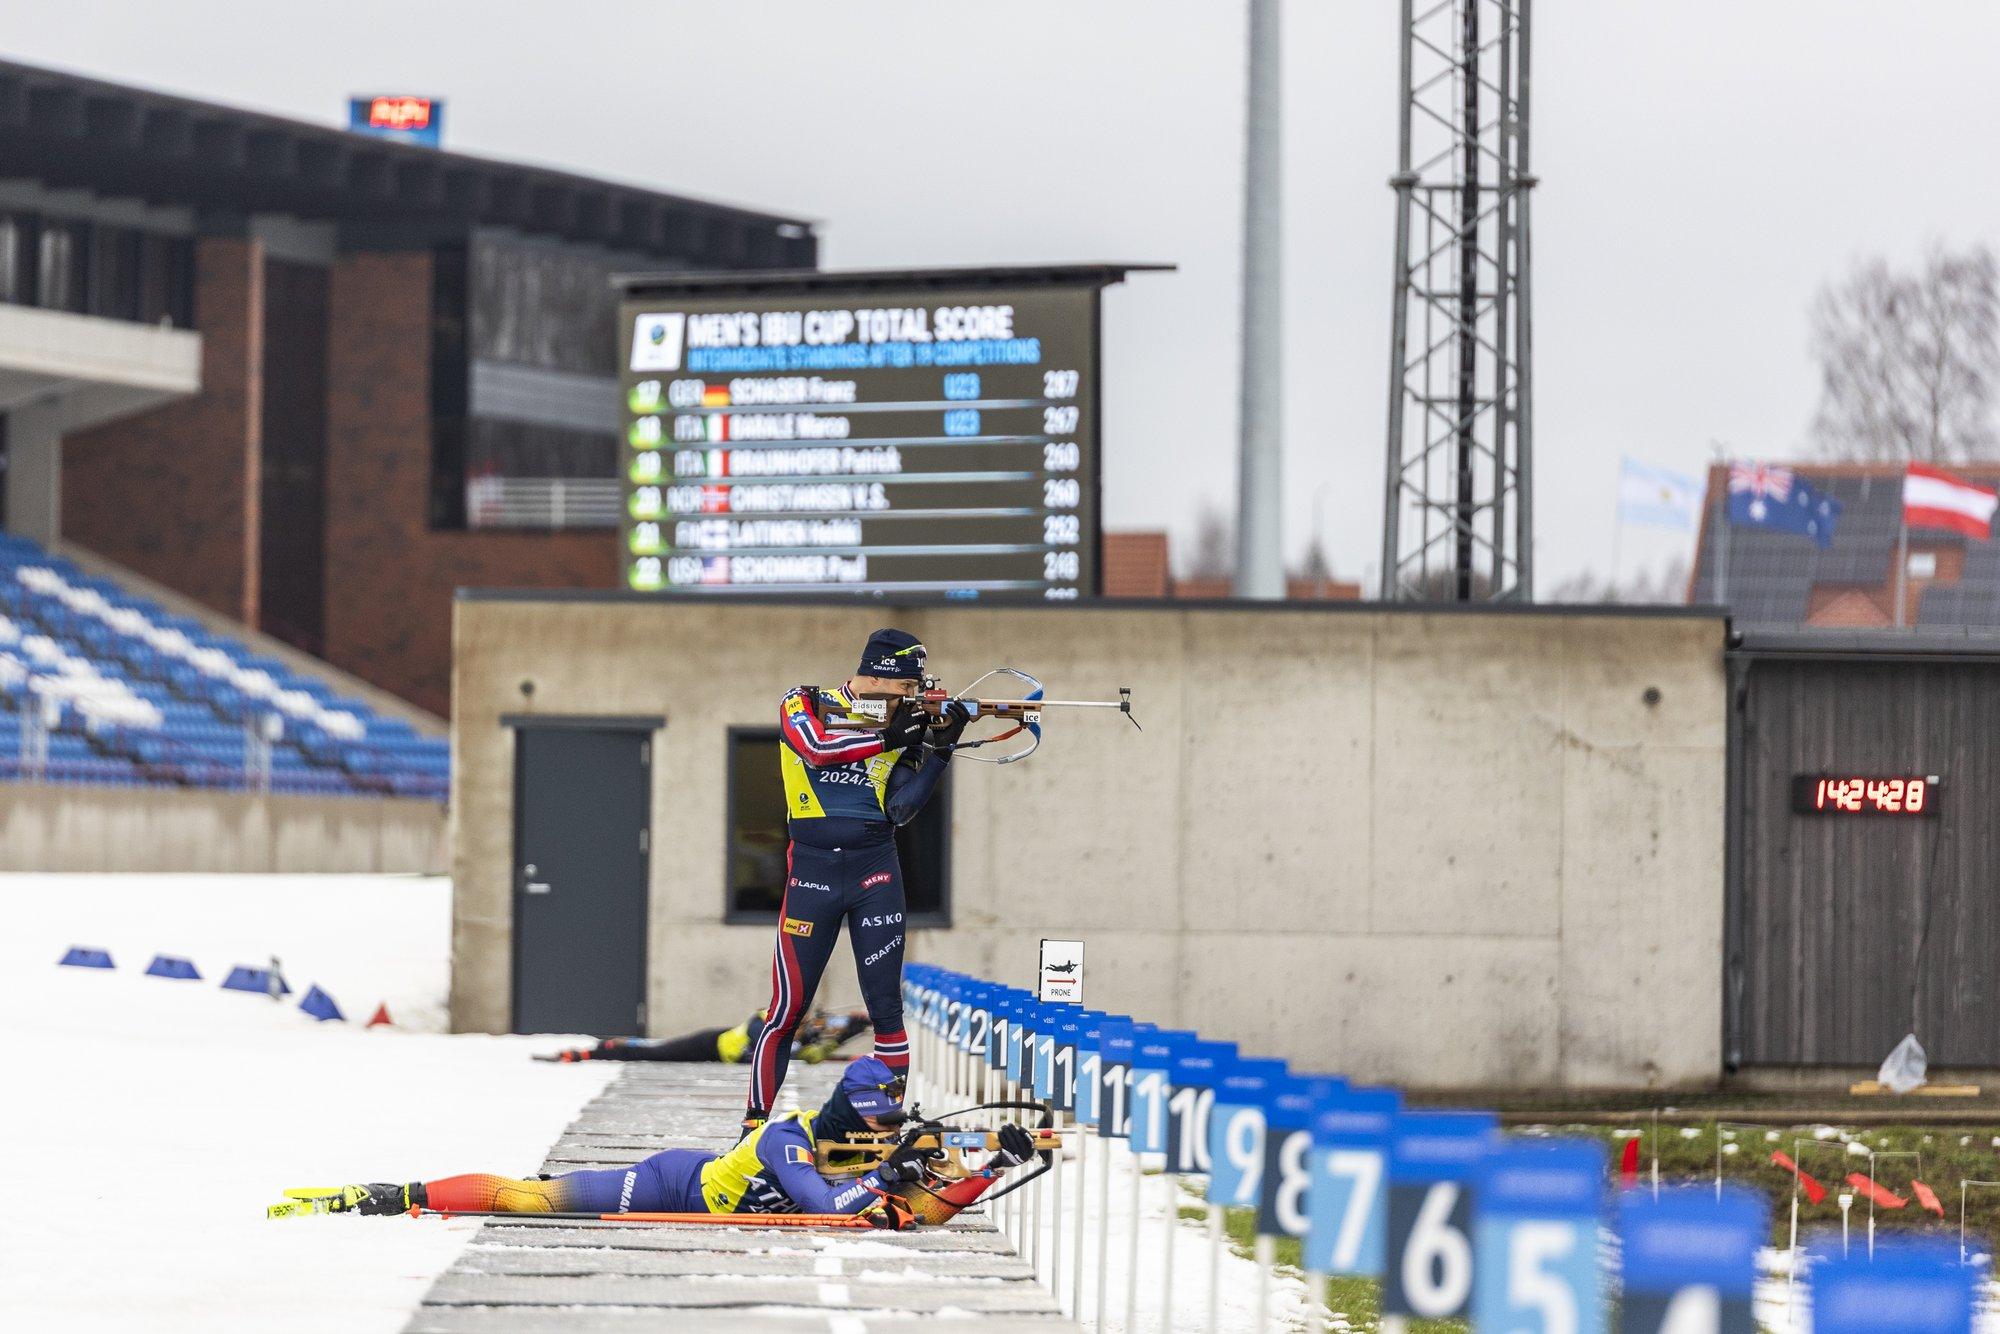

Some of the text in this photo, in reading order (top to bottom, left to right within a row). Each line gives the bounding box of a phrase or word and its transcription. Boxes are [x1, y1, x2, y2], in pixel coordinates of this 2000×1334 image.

[687, 305, 1014, 347] MEN'S IBU CUP TOTAL SCORE
[688, 346, 788, 372] INTERMEDIATE
[789, 343, 866, 369] STANDINGS
[869, 341, 913, 367] AFTER
[935, 337, 1041, 365] COMPETITIONS
[674, 415, 705, 442] ITA
[674, 451, 705, 477] ITA
[668, 557, 703, 584] USA
[873, 664, 897, 673] CRAFT
[881, 655, 896, 666] ice
[1025, 713, 1039, 722] ice
[798, 880, 831, 892] LAPUA
[864, 874, 889, 887] MENY
[864, 939, 897, 966] CRAFT
[1050, 988, 1072, 997] PRONE
[970, 1009, 988, 1054] 2
[994, 1019, 1008, 1067] 1
[1039, 1038, 1055, 1095] 1
[1055, 1046, 1077, 1108] 1
[852, 1099, 877, 1108] MANIA
[1081, 1055, 1101, 1119] 1
[1226, 1107, 1268, 1202] 9
[1275, 1130, 1312, 1235] 8
[1328, 1151, 1384, 1270] 7
[1402, 1180, 1472, 1317] 6
[1508, 1222, 1577, 1334] 5
